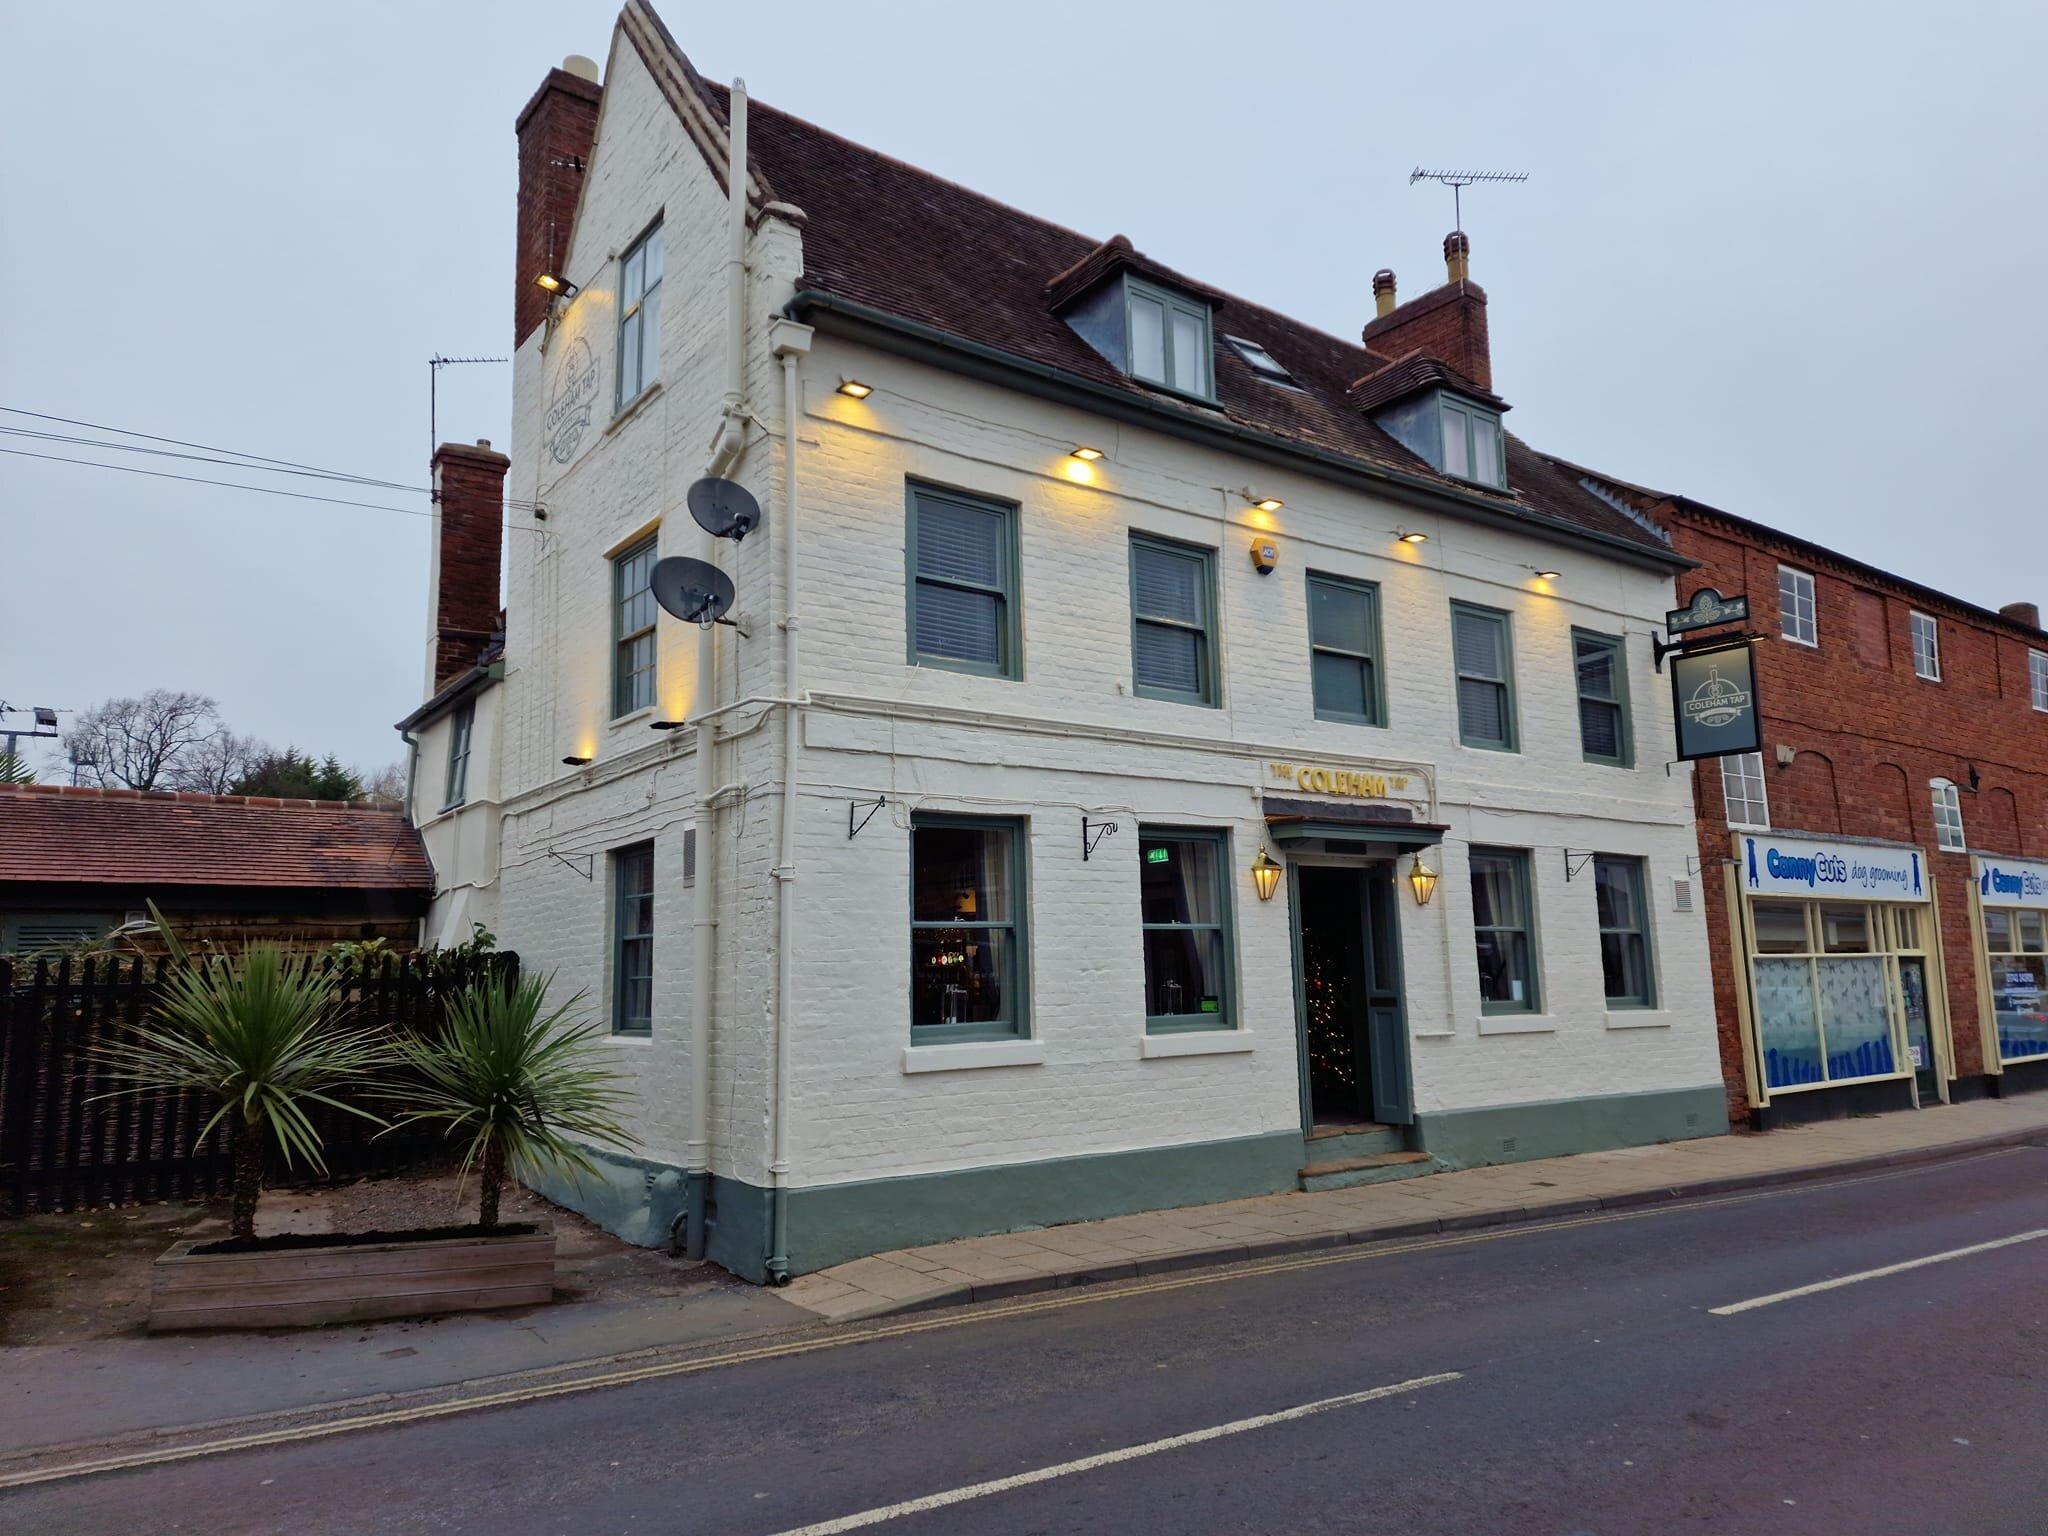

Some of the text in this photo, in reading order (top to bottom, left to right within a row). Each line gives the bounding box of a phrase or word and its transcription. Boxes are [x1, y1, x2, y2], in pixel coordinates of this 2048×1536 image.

[1689, 695, 1745, 710] COLEHAM TAP
[1297, 766, 1387, 797] COLEHAM
[1851, 860, 1868, 888] dog
[1870, 863, 1909, 891] grooming
